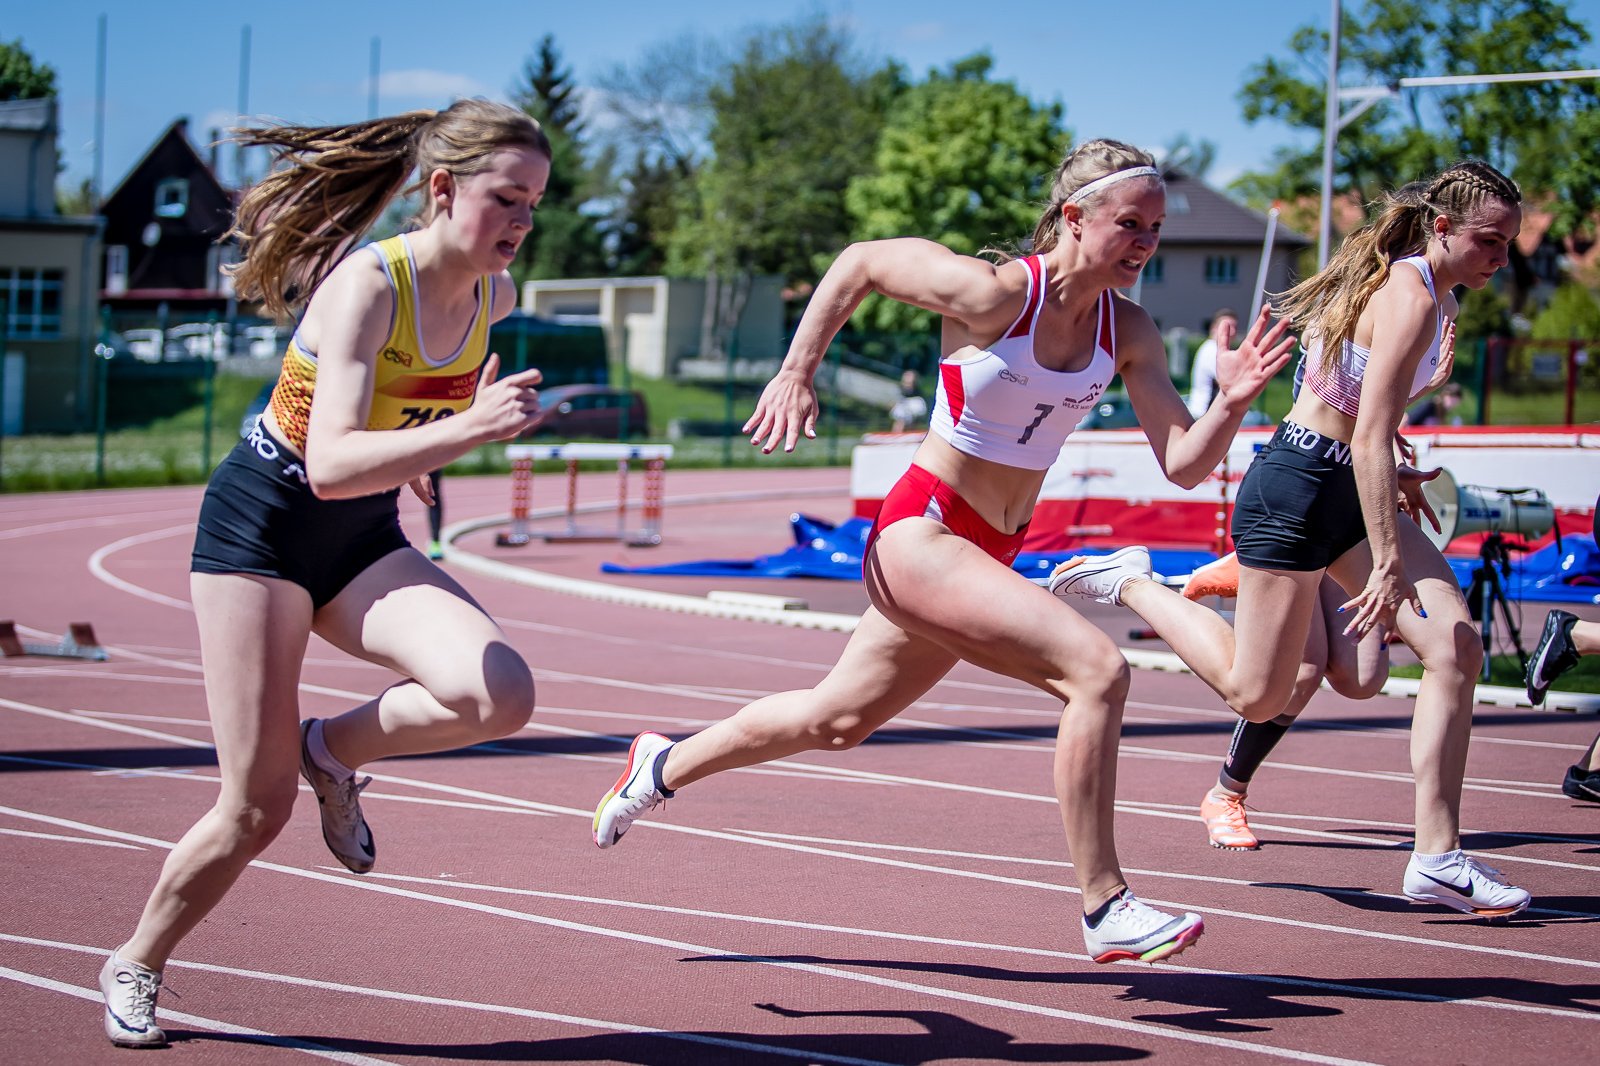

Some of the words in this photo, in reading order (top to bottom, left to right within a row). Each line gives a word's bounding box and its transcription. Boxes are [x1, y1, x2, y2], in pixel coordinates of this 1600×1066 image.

[383, 347, 413, 368] esa
[998, 368, 1029, 386] esa
[1017, 403, 1055, 445] 7
[1282, 421, 1320, 450] PRO
[1323, 440, 1353, 467] NI
